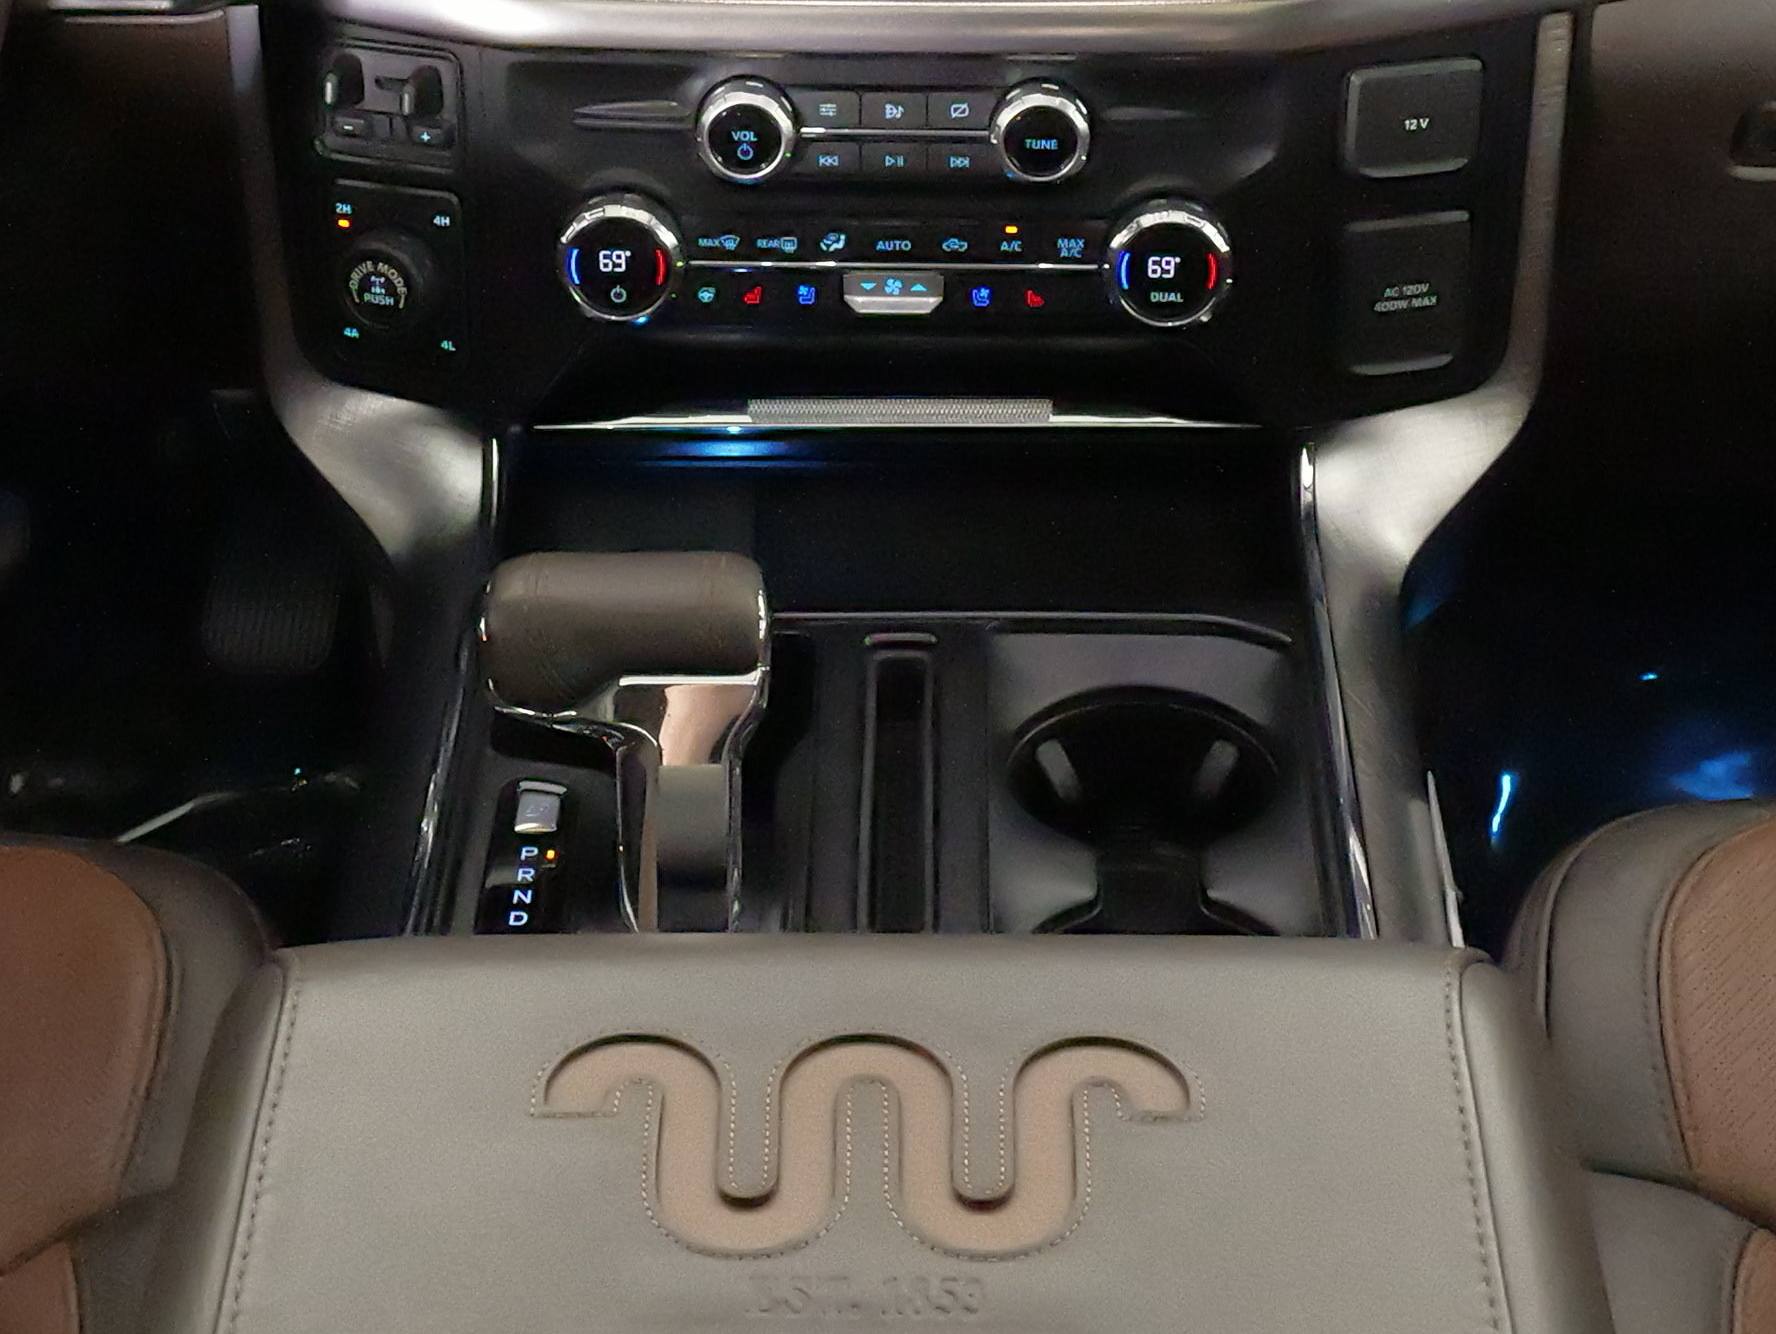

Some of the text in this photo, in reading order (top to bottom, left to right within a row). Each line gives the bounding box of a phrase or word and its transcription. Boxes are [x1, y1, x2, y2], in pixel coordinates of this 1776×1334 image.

[731, 130, 758, 142] VOL
[1024, 138, 1059, 151] TUNE
[335, 202, 352, 214] 2H
[433, 215, 450, 227] 4H
[875, 240, 912, 252] AUTO
[1000, 240, 1022, 252] A/C
[1056, 238, 1085, 249] MAX
[348, 260, 408, 295] DRIVE MODE
[363, 292, 395, 305] PUSH
[1150, 291, 1184, 303] DUAL
[441, 340, 456, 351] 4L
[520, 846, 539, 861] P
[517, 868, 535, 882] R
[512, 889, 533, 905] N
[508, 910, 528, 926] D
